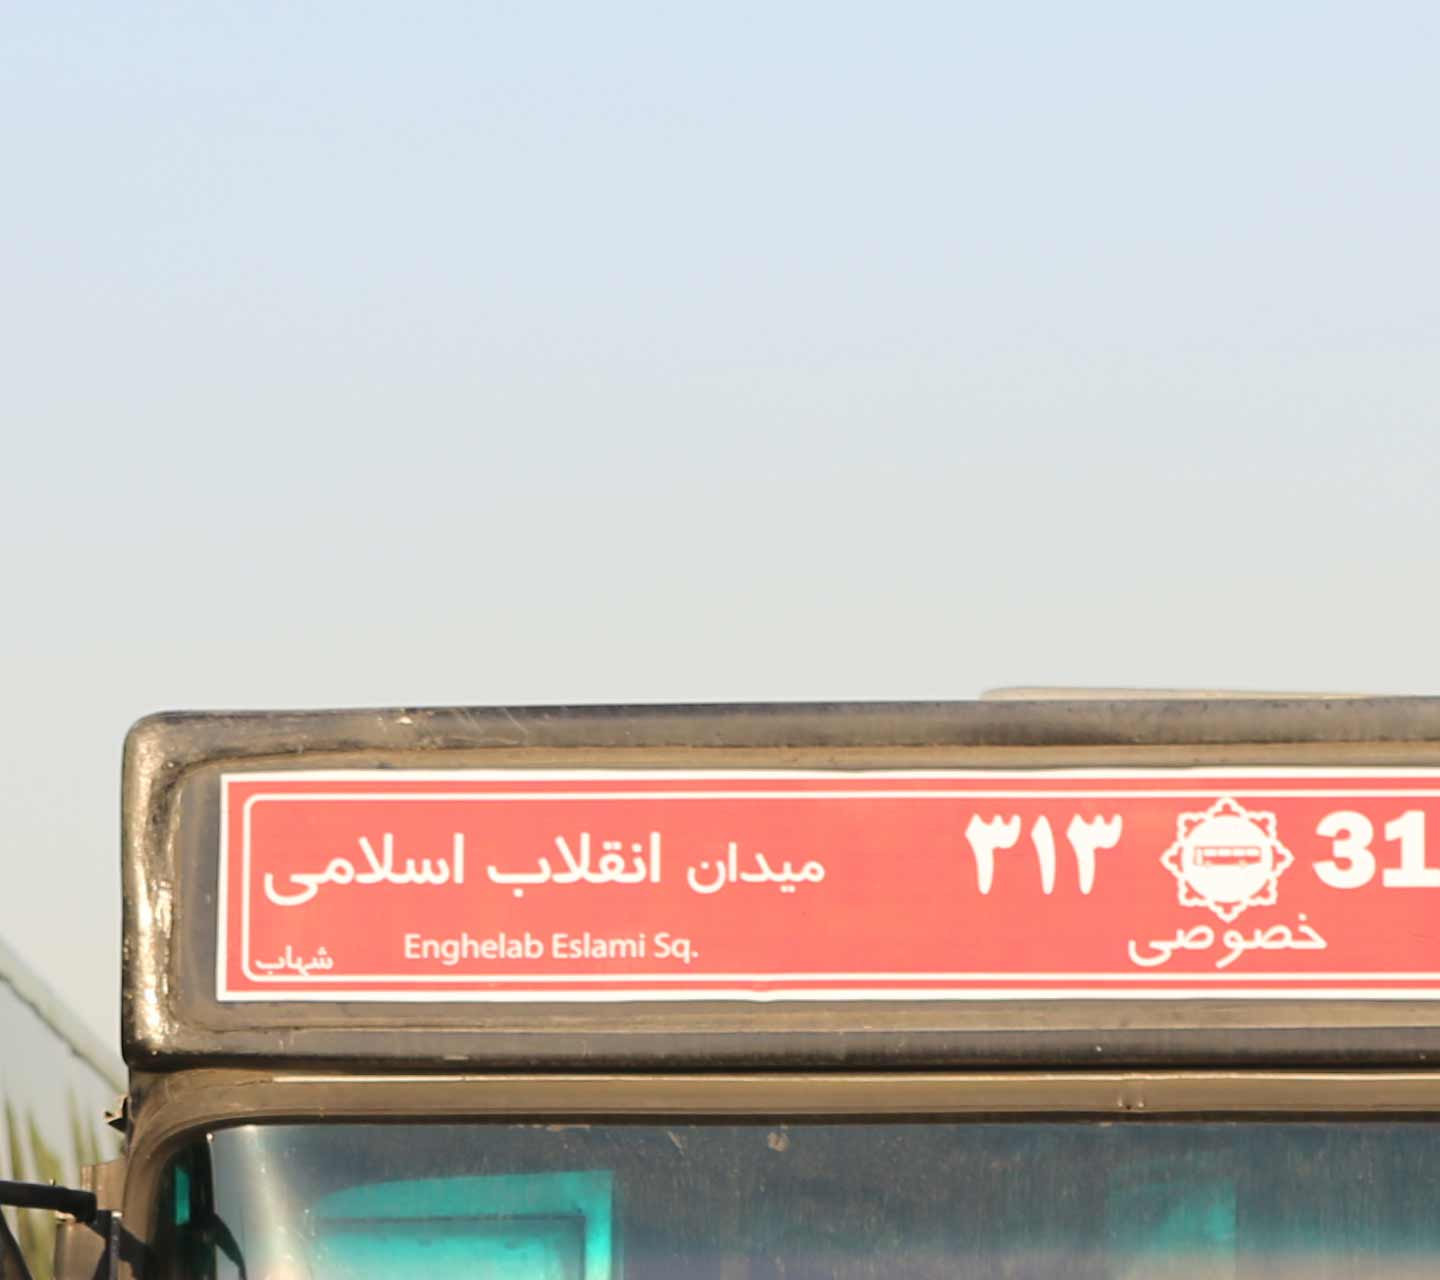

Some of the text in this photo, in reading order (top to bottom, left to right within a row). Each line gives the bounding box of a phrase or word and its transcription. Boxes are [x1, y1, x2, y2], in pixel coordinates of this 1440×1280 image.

[263, 832, 826, 906] میدان انقلاب اسلامی
[963, 812, 1124, 895] ۳۱۳
[255, 946, 334, 977] شهاب
[403, 931, 700, 966] Enghelab Eslami Sq.
[1127, 913, 1328, 969] خصوصی
